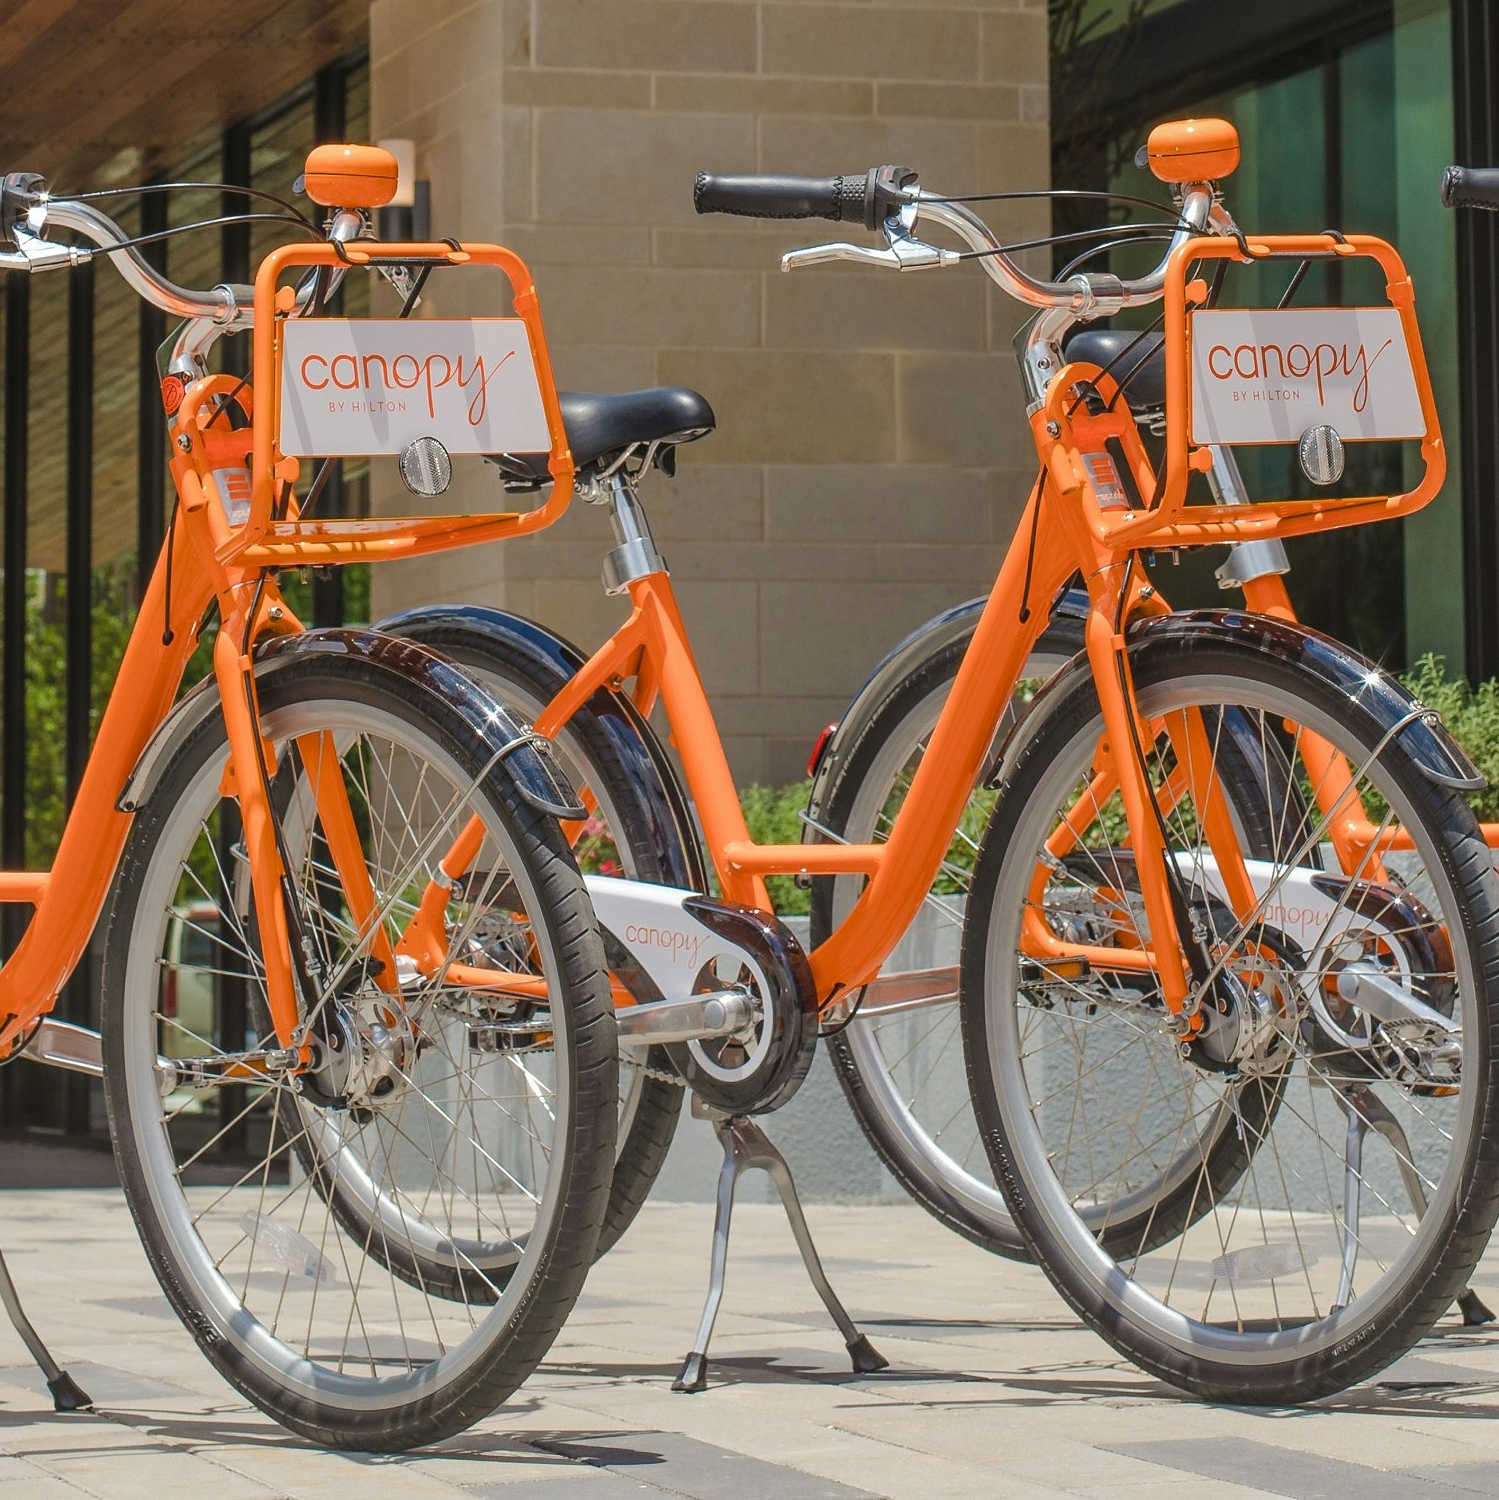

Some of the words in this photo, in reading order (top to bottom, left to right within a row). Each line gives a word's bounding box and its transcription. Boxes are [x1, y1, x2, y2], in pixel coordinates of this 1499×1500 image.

[300, 350, 516, 426] canopy
[1207, 338, 1393, 413] canopy
[1233, 391, 1247, 402] BY
[1253, 389, 1300, 401] HILTON
[328, 402, 345, 413] BY
[352, 401, 407, 413] HILTON
[625, 925, 711, 970] canopy
